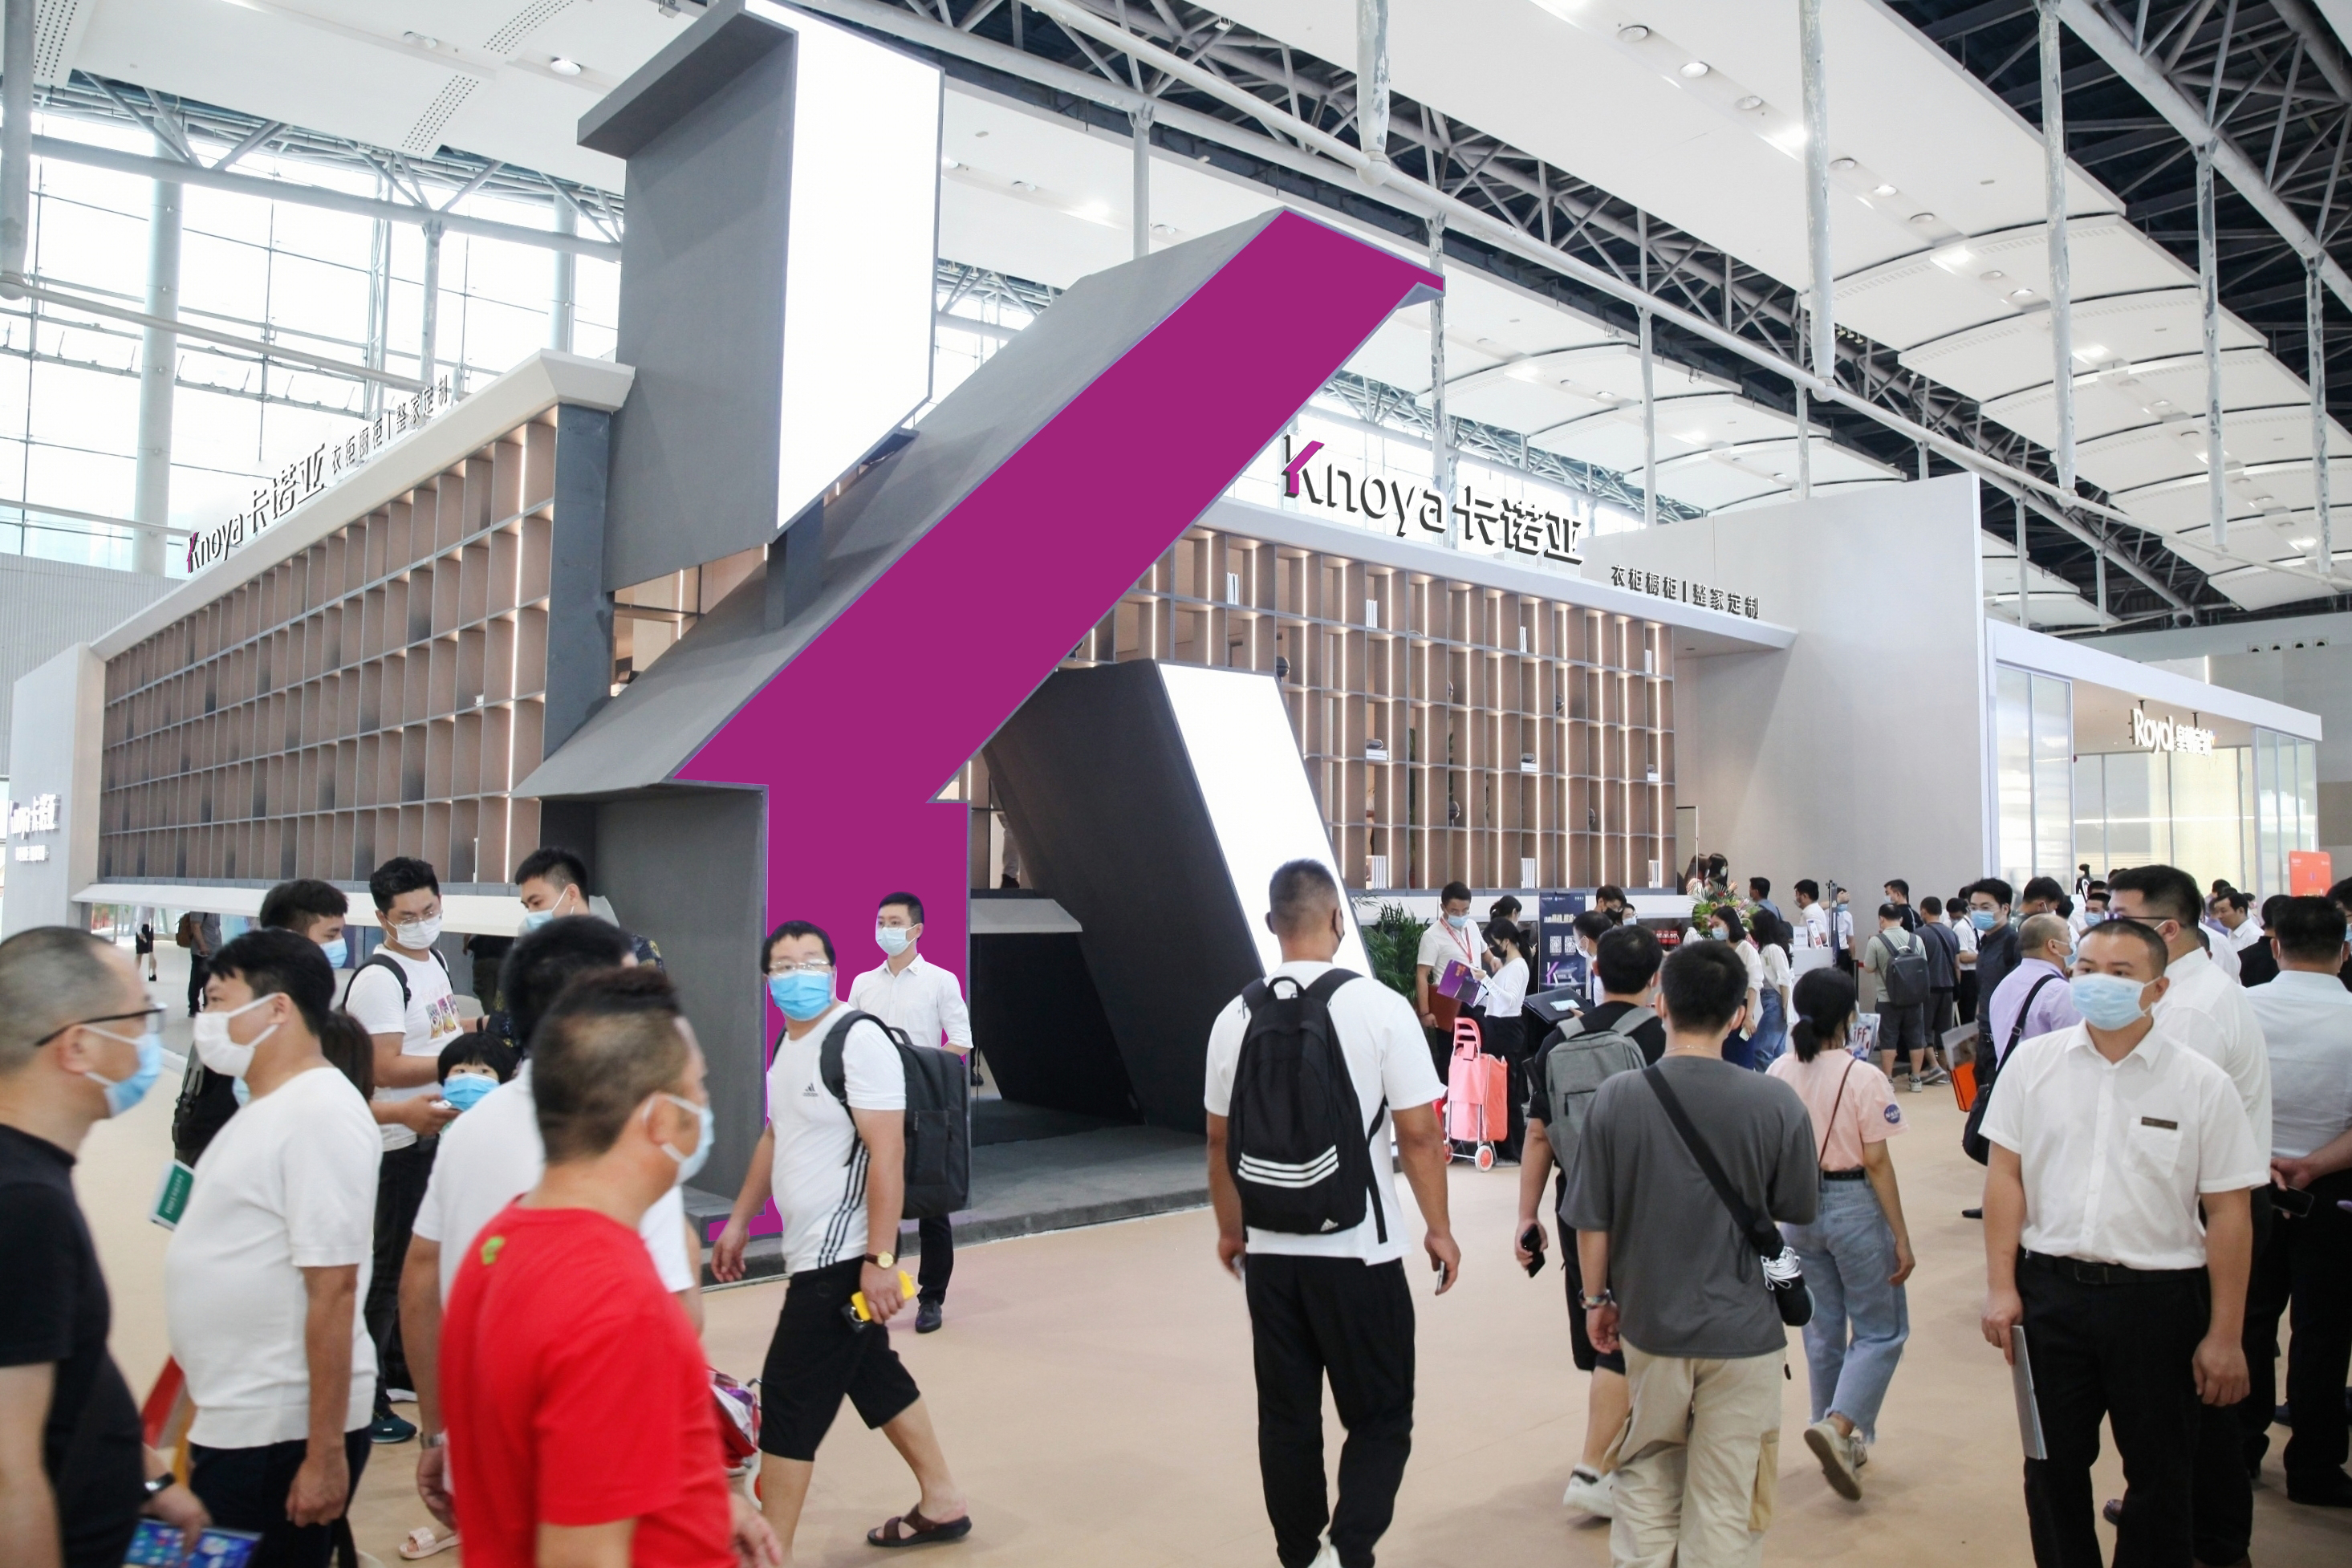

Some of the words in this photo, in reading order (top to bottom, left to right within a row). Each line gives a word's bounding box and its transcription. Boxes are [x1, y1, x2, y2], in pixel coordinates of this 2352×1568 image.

[187, 514, 243, 573] Knoya
[247, 443, 328, 534] 卡诺亚
[1282, 434, 1446, 537] Knoya
[1452, 485, 1583, 566] 卡诺亚
